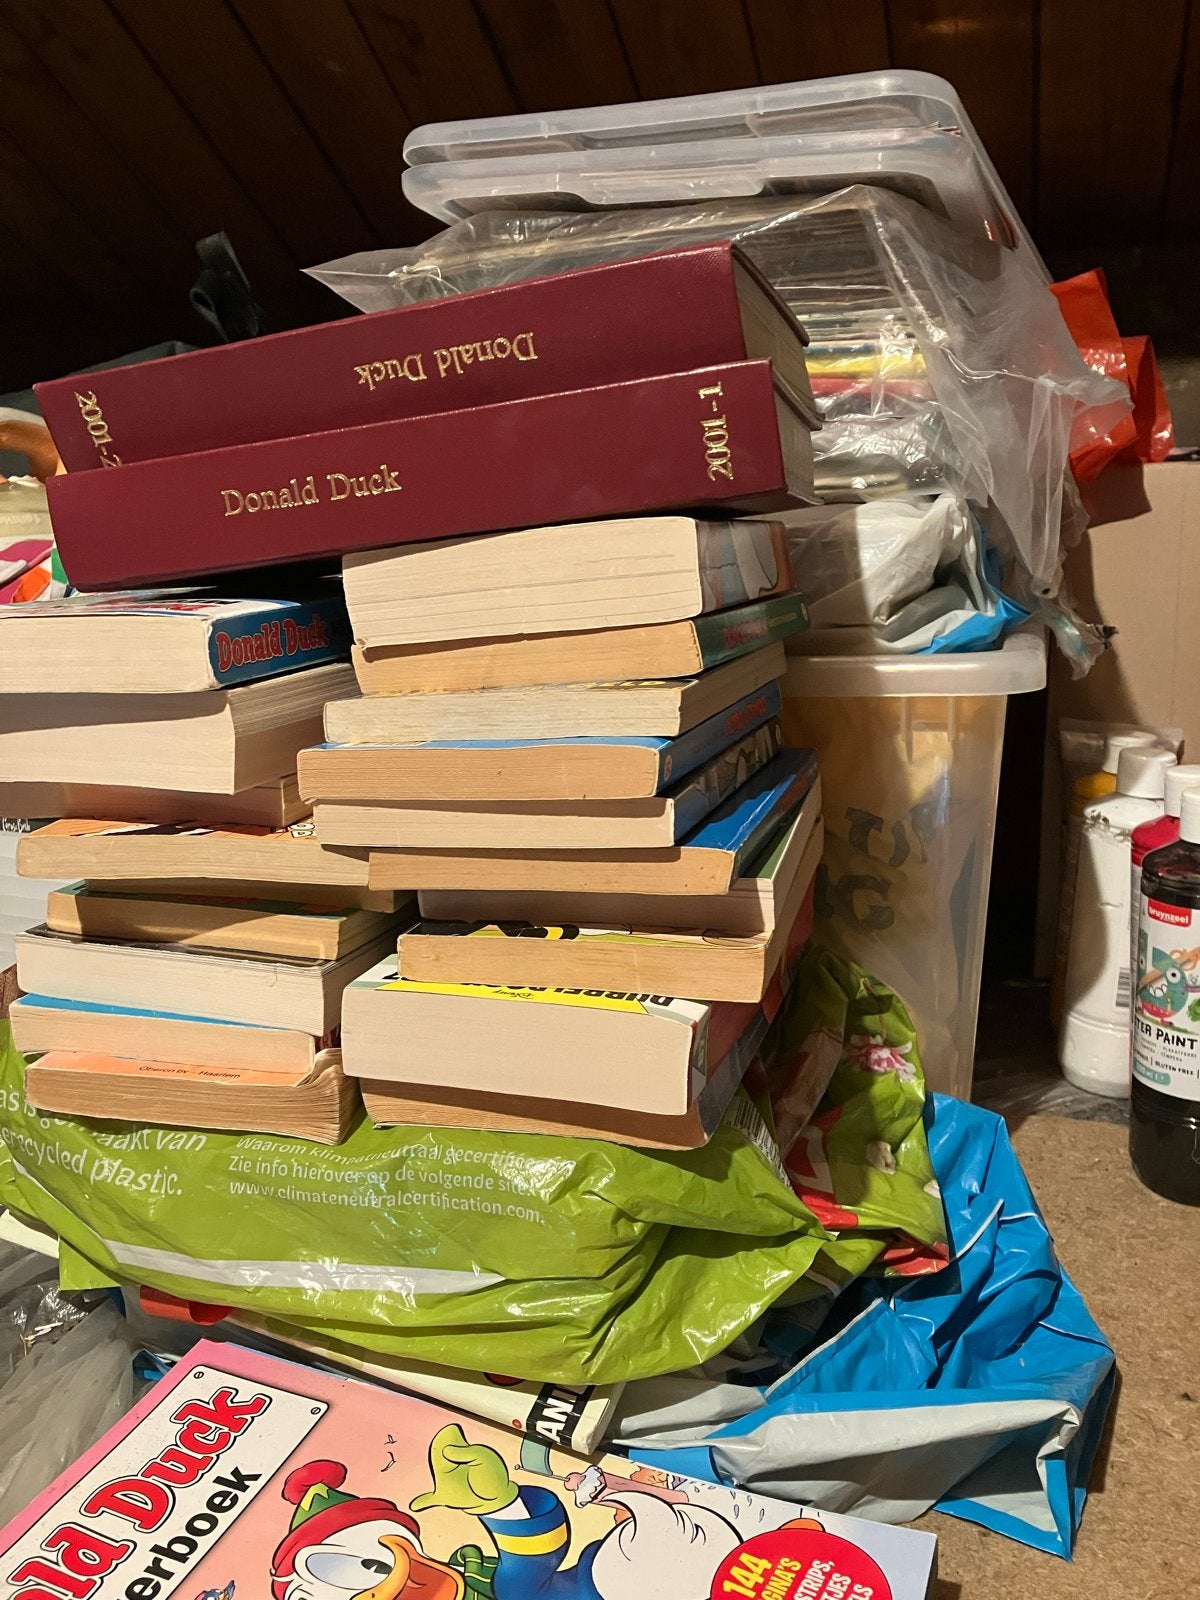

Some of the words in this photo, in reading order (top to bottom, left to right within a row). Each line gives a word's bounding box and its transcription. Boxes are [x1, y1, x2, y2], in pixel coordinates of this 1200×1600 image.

[354, 354, 427, 391] Duck
[434, 332, 538, 378] Donald
[220, 476, 319, 517] Donald
[326, 464, 402, 501] Duck
[216, 621, 283, 672] Donald
[282, 613, 328, 656] Duck
[1149, 905, 1189, 924] bruynzeel
[1156, 1028, 1198, 1050] PAINT
[1155, 1060, 1177, 1072] GLUTEN
[1178, 1067, 1194, 1076] FREE
[156, 1130, 208, 1151] van
[236, 1137, 307, 1155] Waarom
[90, 1157, 183, 1196] plastic.
[229, 1155, 252, 1172] Zie
[256, 1157, 288, 1177] info
[292, 1162, 364, 1184] hierover
[367, 1170, 390, 1185] op
[395, 1164, 415, 1181] de
[419, 1169, 494, 1189] volgende
[6, 1522, 137, 1600] ld
[80, 1387, 272, 1533] Duck
[118, 1466, 262, 1600] erboek
[723, 1553, 772, 1599] 144
